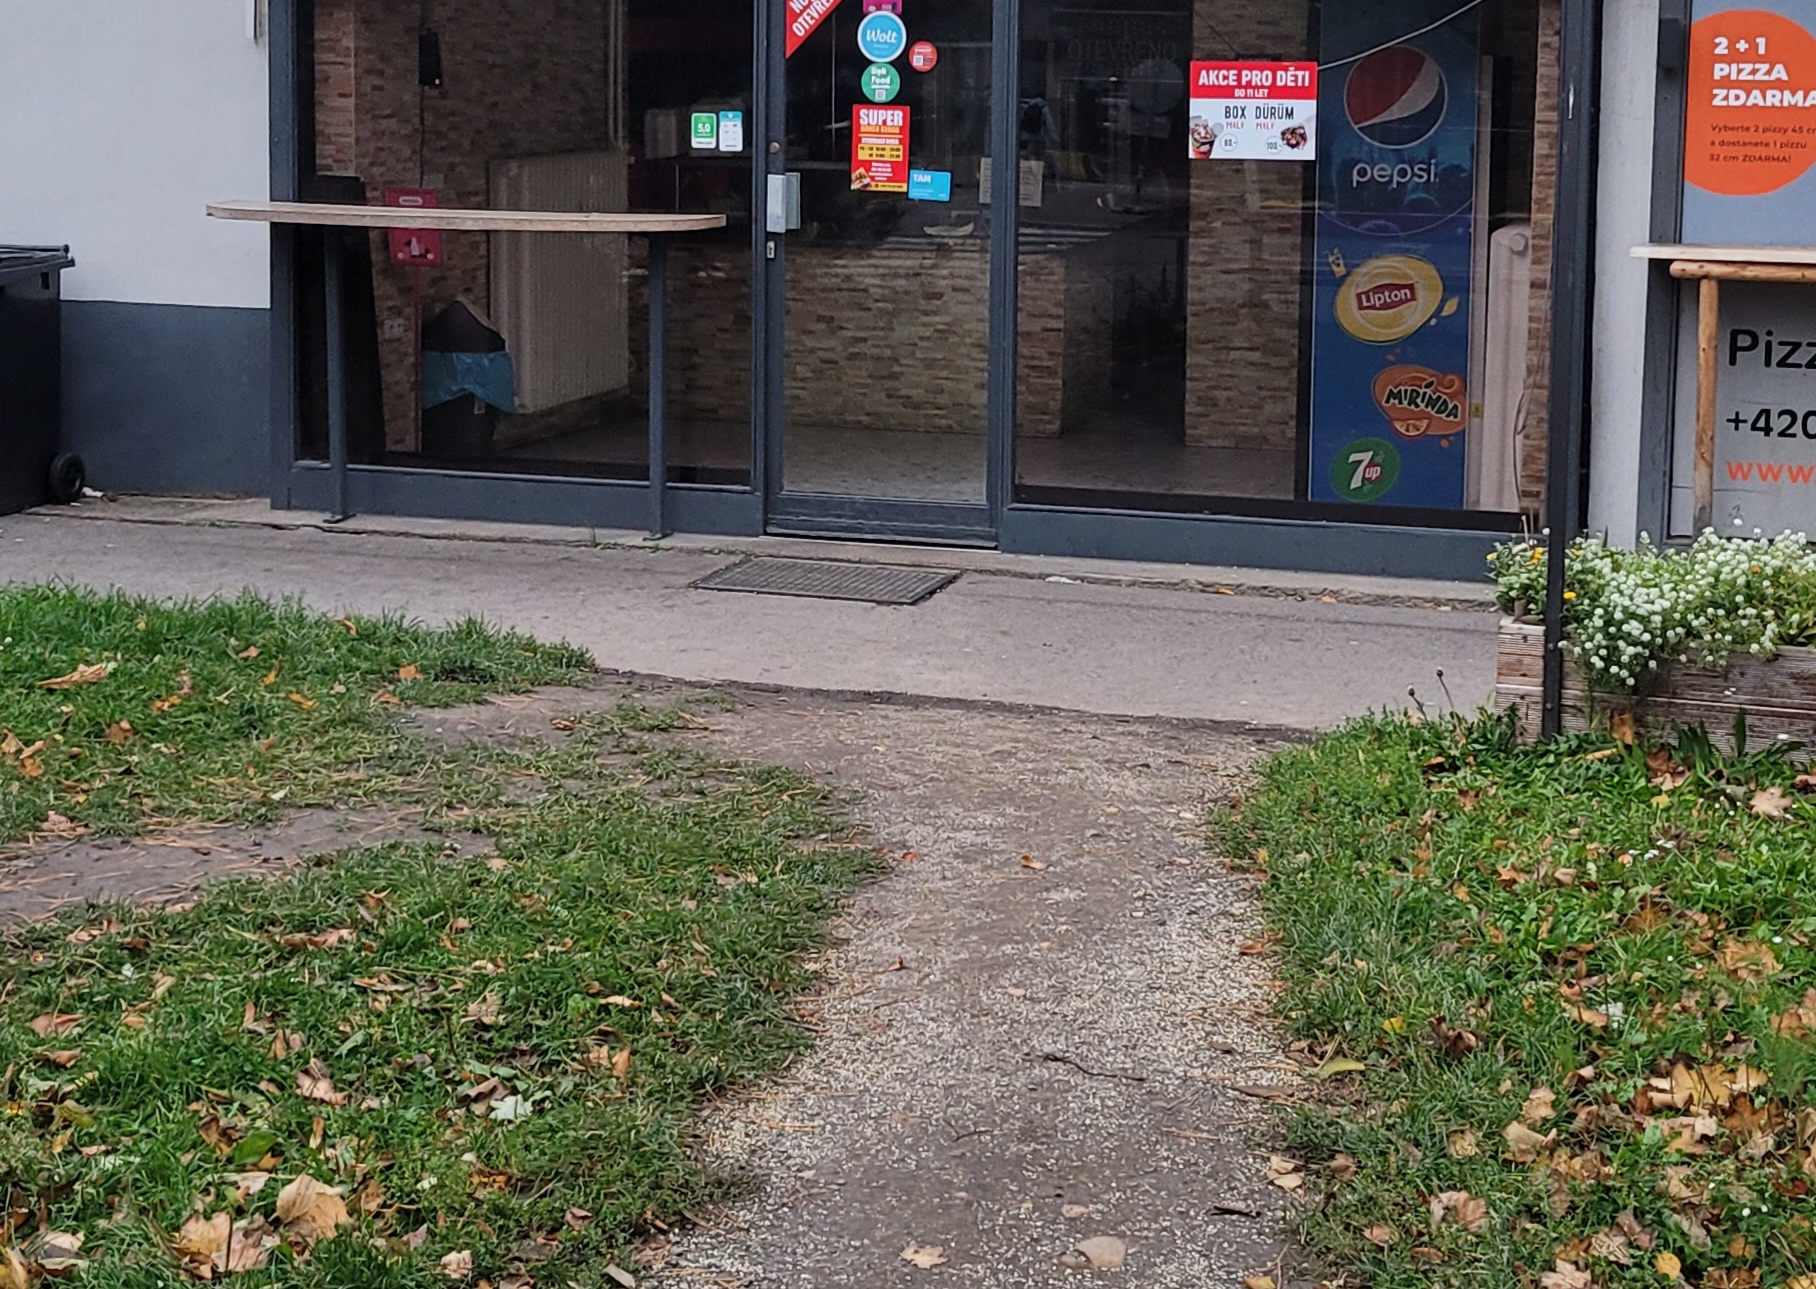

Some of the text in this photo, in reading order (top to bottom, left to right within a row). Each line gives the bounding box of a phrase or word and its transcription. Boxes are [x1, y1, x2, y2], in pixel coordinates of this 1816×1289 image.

[866, 29, 898, 43] Wolt
[1713, 36, 1729, 54] 2
[1755, 37, 1766, 55] 1
[1198, 67, 1310, 87] AKCE PRO DĚTI
[1713, 63, 1789, 81] PIZZA
[1234, 89, 1245, 97] DO
[1254, 89, 1269, 98] LET
[1712, 89, 1816, 107] ZDARMA
[859, 109, 903, 127] SUPER
[1224, 103, 1294, 120] BOX DÜRÜM
[1711, 124, 1750, 133] Vyberte
[1753, 125, 1759, 133] 2
[1762, 124, 1789, 135] pizzy
[1718, 140, 1770, 148] dostanete
[1780, 141, 1807, 149] pizzu
[1352, 159, 1436, 187] pepsi
[1361, 286, 1411, 307] Lipton
